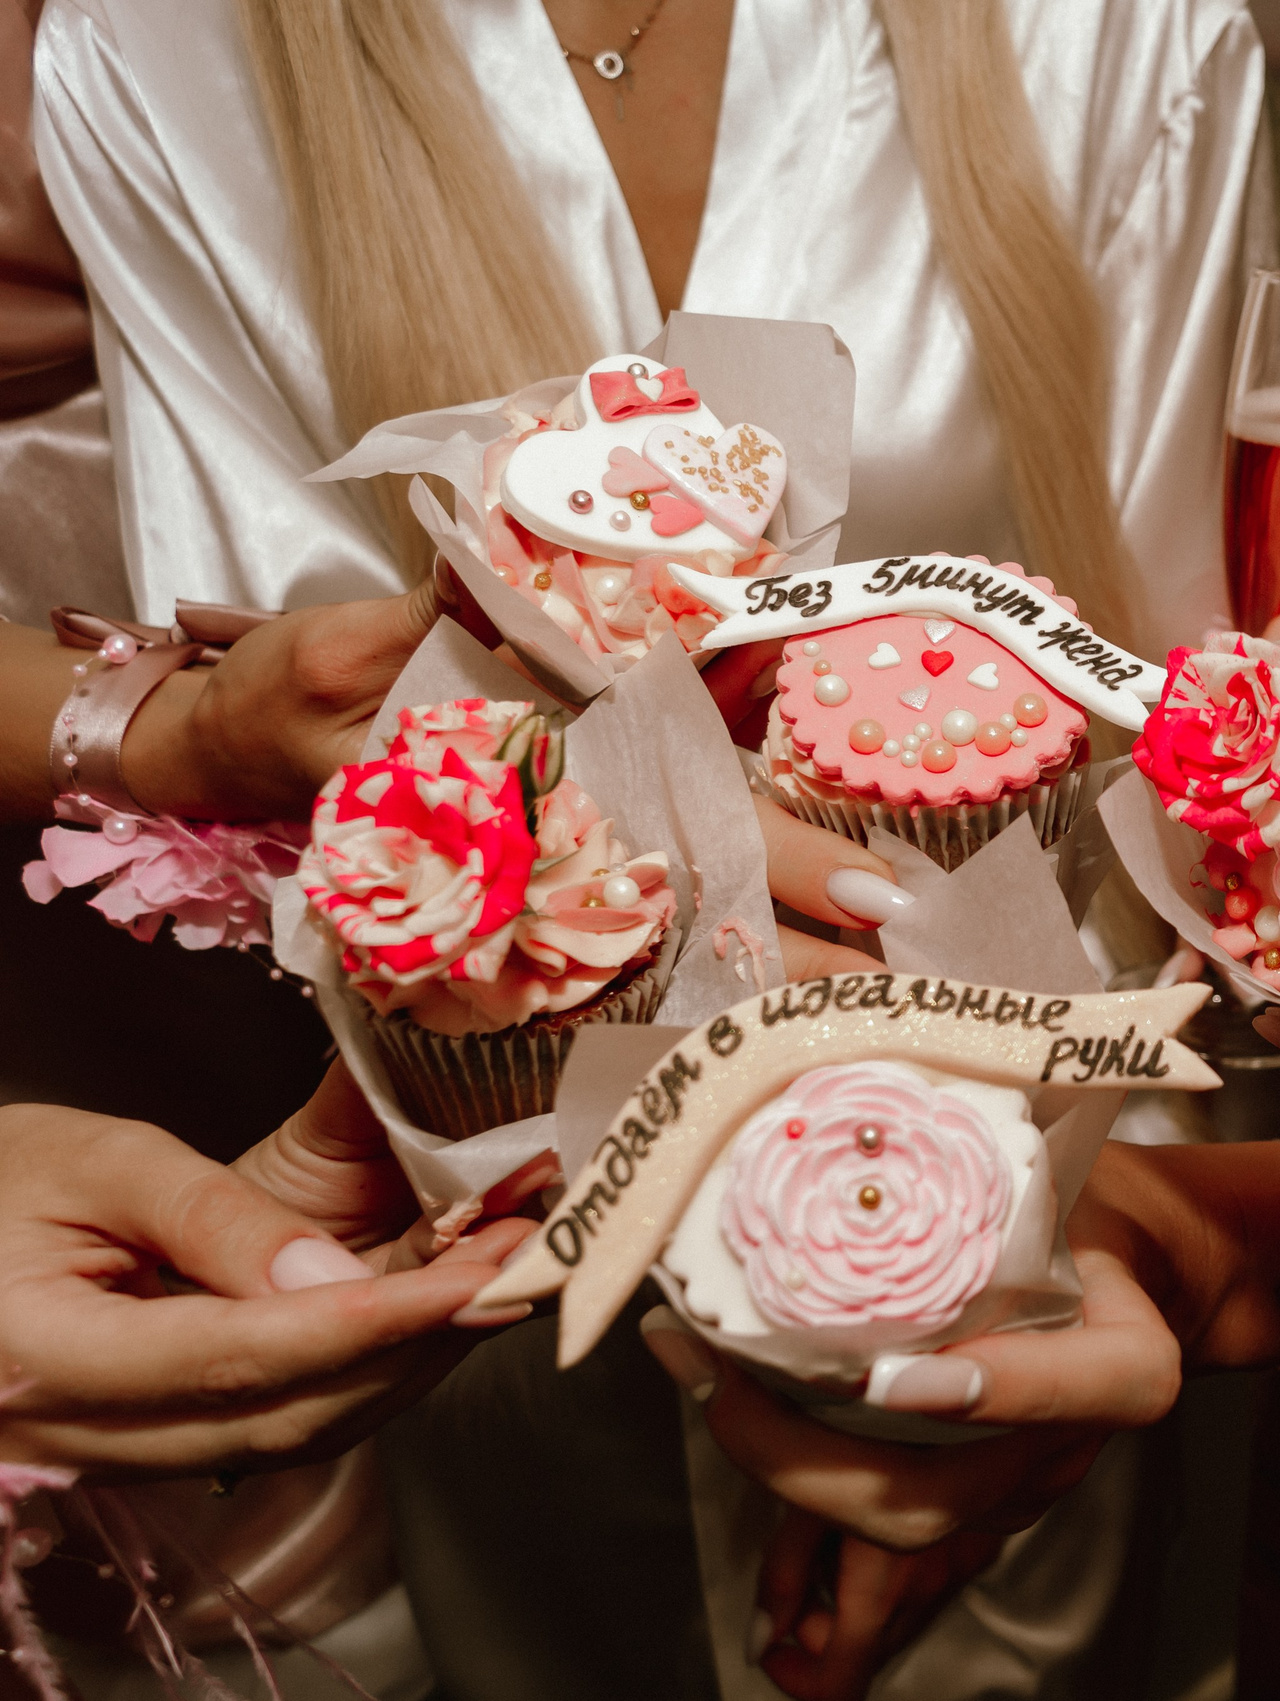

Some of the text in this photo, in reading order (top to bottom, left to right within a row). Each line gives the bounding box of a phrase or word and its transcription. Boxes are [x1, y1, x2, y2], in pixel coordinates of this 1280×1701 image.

[745, 574, 833, 618] Без
[1038, 621, 1143, 692] жена
[706, 1018, 746, 1058] в
[761, 973, 1072, 1033] идеальные
[1039, 1026, 1171, 1083] руки
